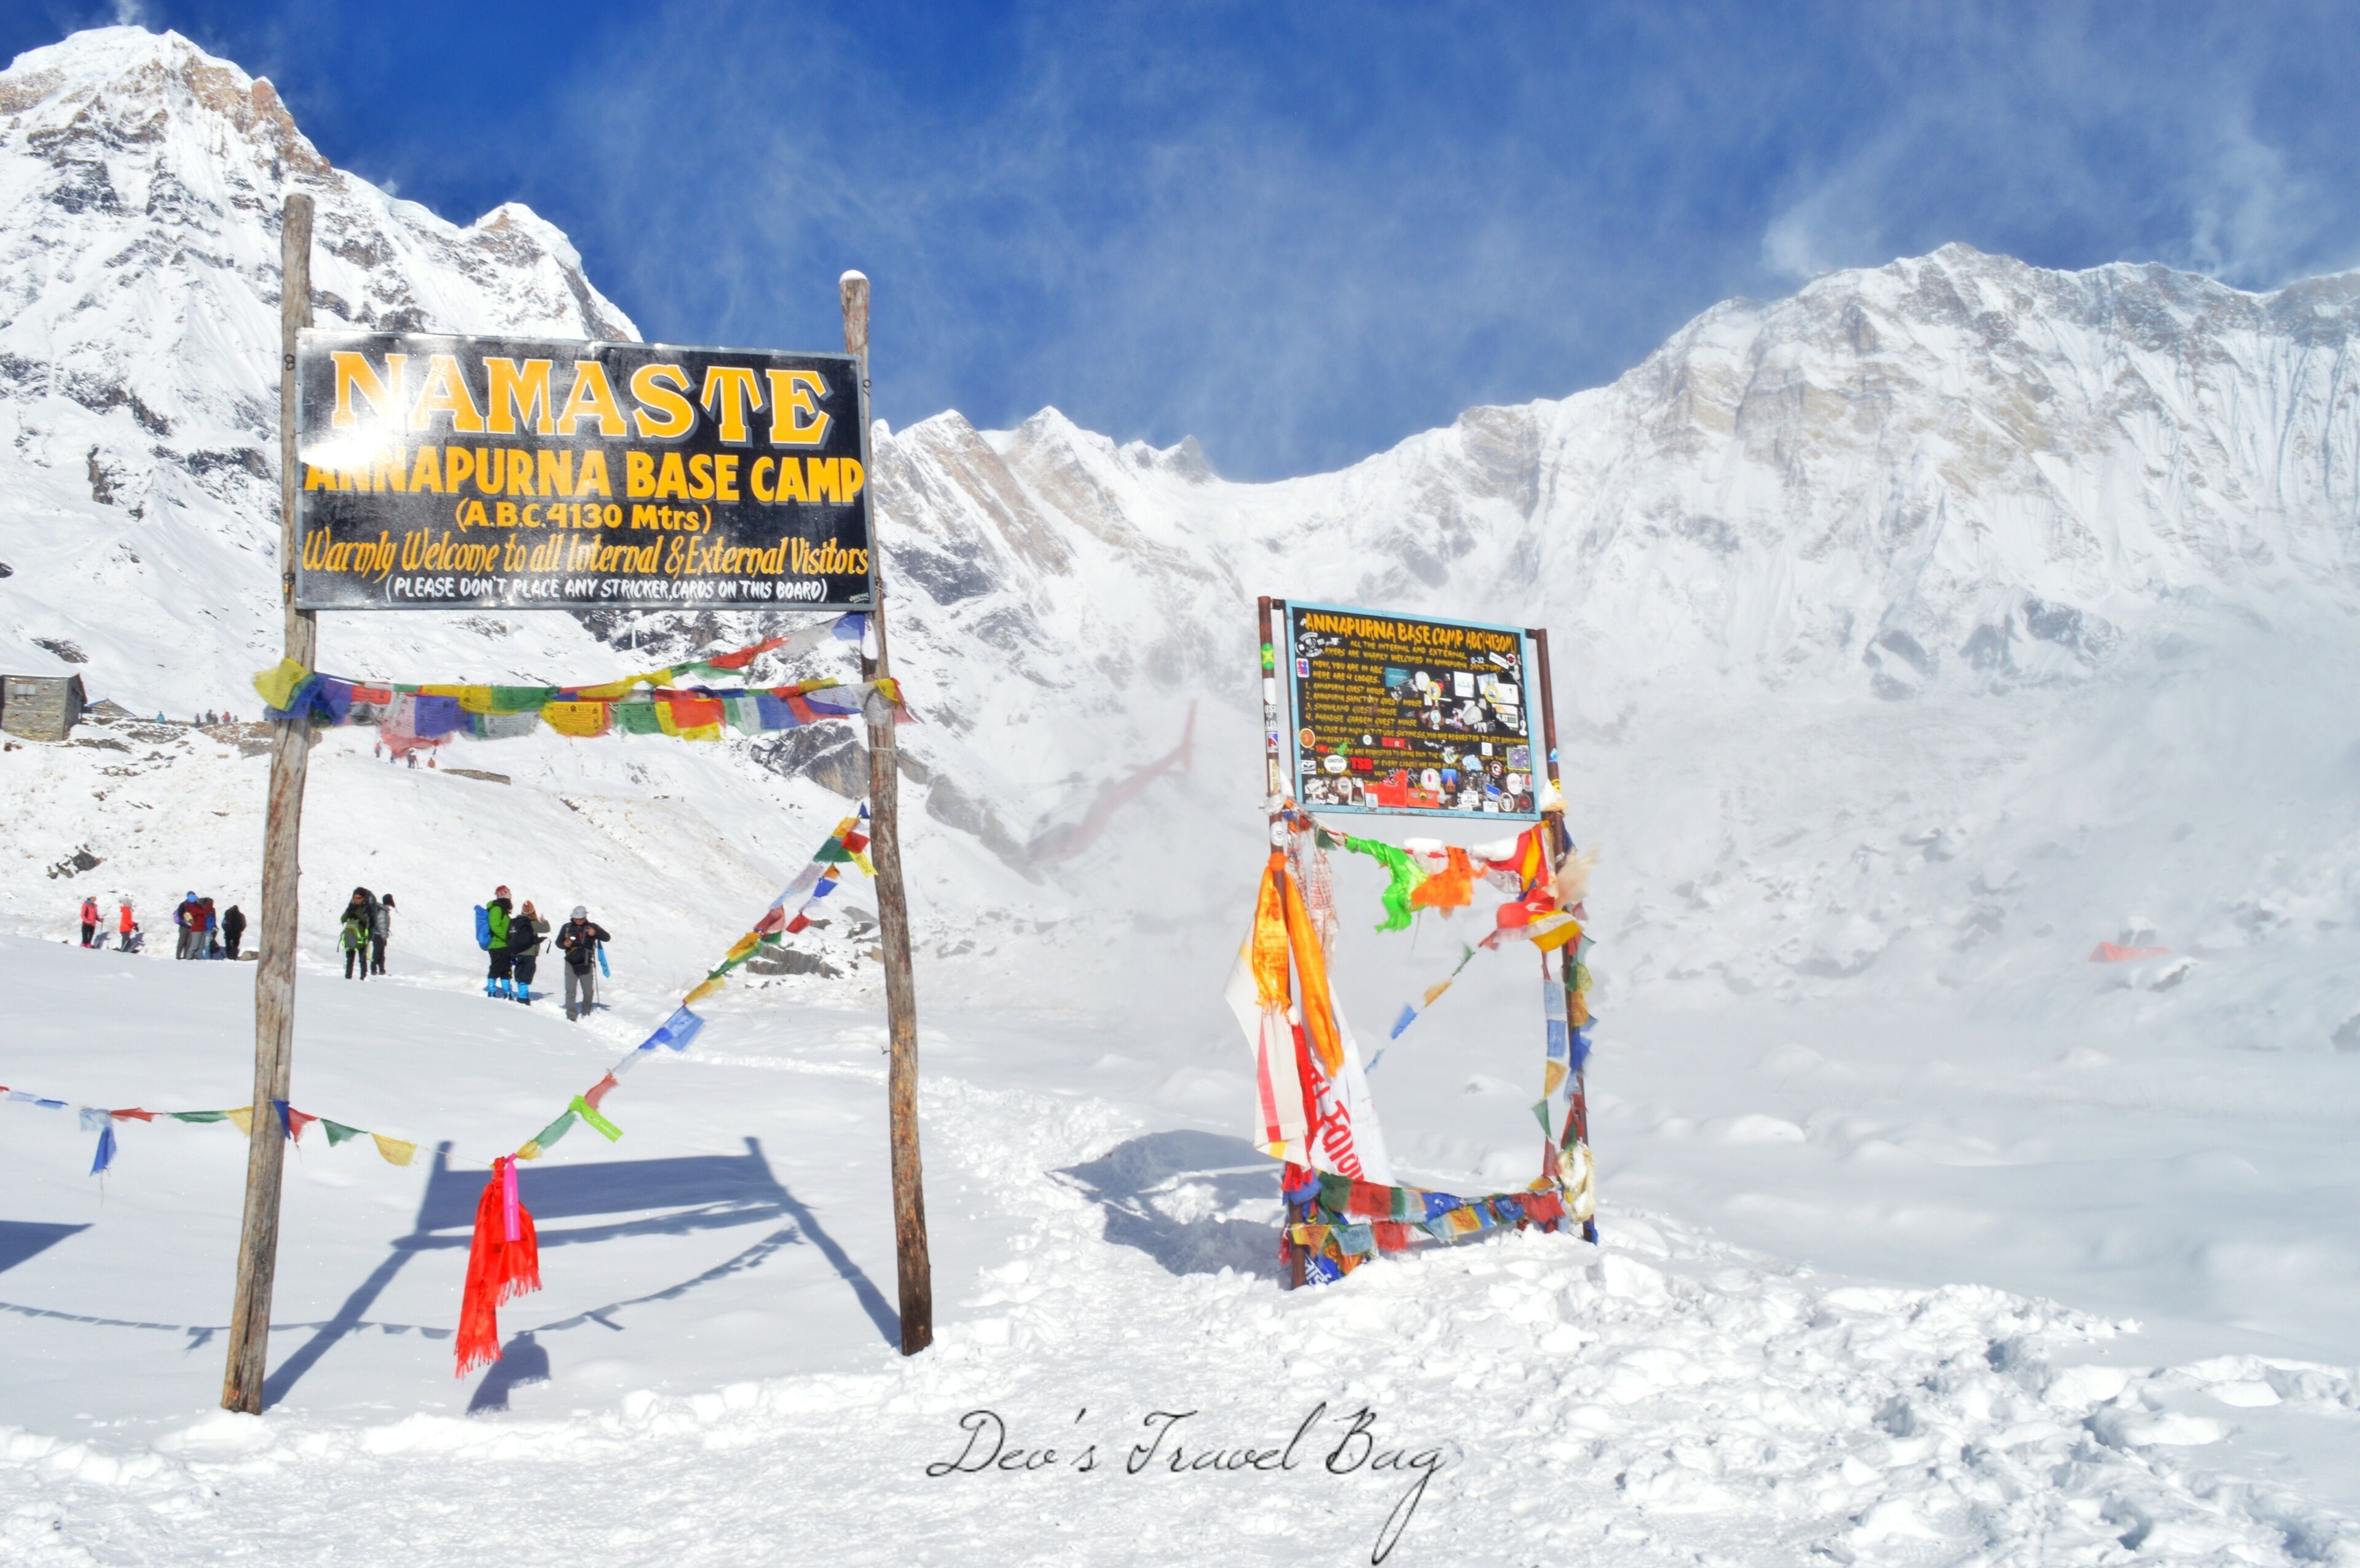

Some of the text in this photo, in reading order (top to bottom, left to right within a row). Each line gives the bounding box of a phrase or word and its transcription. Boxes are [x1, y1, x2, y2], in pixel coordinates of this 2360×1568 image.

[330, 350, 833, 447] NAMASTE
[304, 444, 865, 506] ANNAPURNA BASE CAMP
[631, 504, 712, 534] Mtrs)
[302, 526, 398, 583] Warmly
[401, 527, 500, 576] Welcome
[503, 533, 527, 573] to
[530, 533, 565, 573] all
[567, 533, 664, 574] Internal
[791, 536, 869, 575] Visitors
[385, 574, 455, 602] (PLEASE
[460, 576, 508, 598] DON'T
[513, 578, 560, 598] PLACE
[564, 578, 598, 598] ANY
[718, 581, 737, 600] ON
[739, 580, 773, 600] THIS
[776, 578, 828, 603] BOARD)
[1305, 613, 1396, 643] ANNAPURNA
[1397, 622, 1431, 645] BASE
[1432, 627, 1463, 649] CAMP
[1348, 649, 1360, 658] ARE
[1363, 651, 1389, 661] WARMLY
[1434, 659, 1468, 670] ANNAPURNA
[1350, 640, 1362, 648] ALL
[1363, 641, 1377, 649] THE
[1378, 643, 1410, 653] INTERNAL
[1313, 670, 1331, 681] HERE
[1333, 672, 1346, 682] ARE
[1332, 662, 1345, 670] YOU
[1346, 663, 1359, 672] ARE
[1313, 682, 1346, 692] ANNAPURNA
